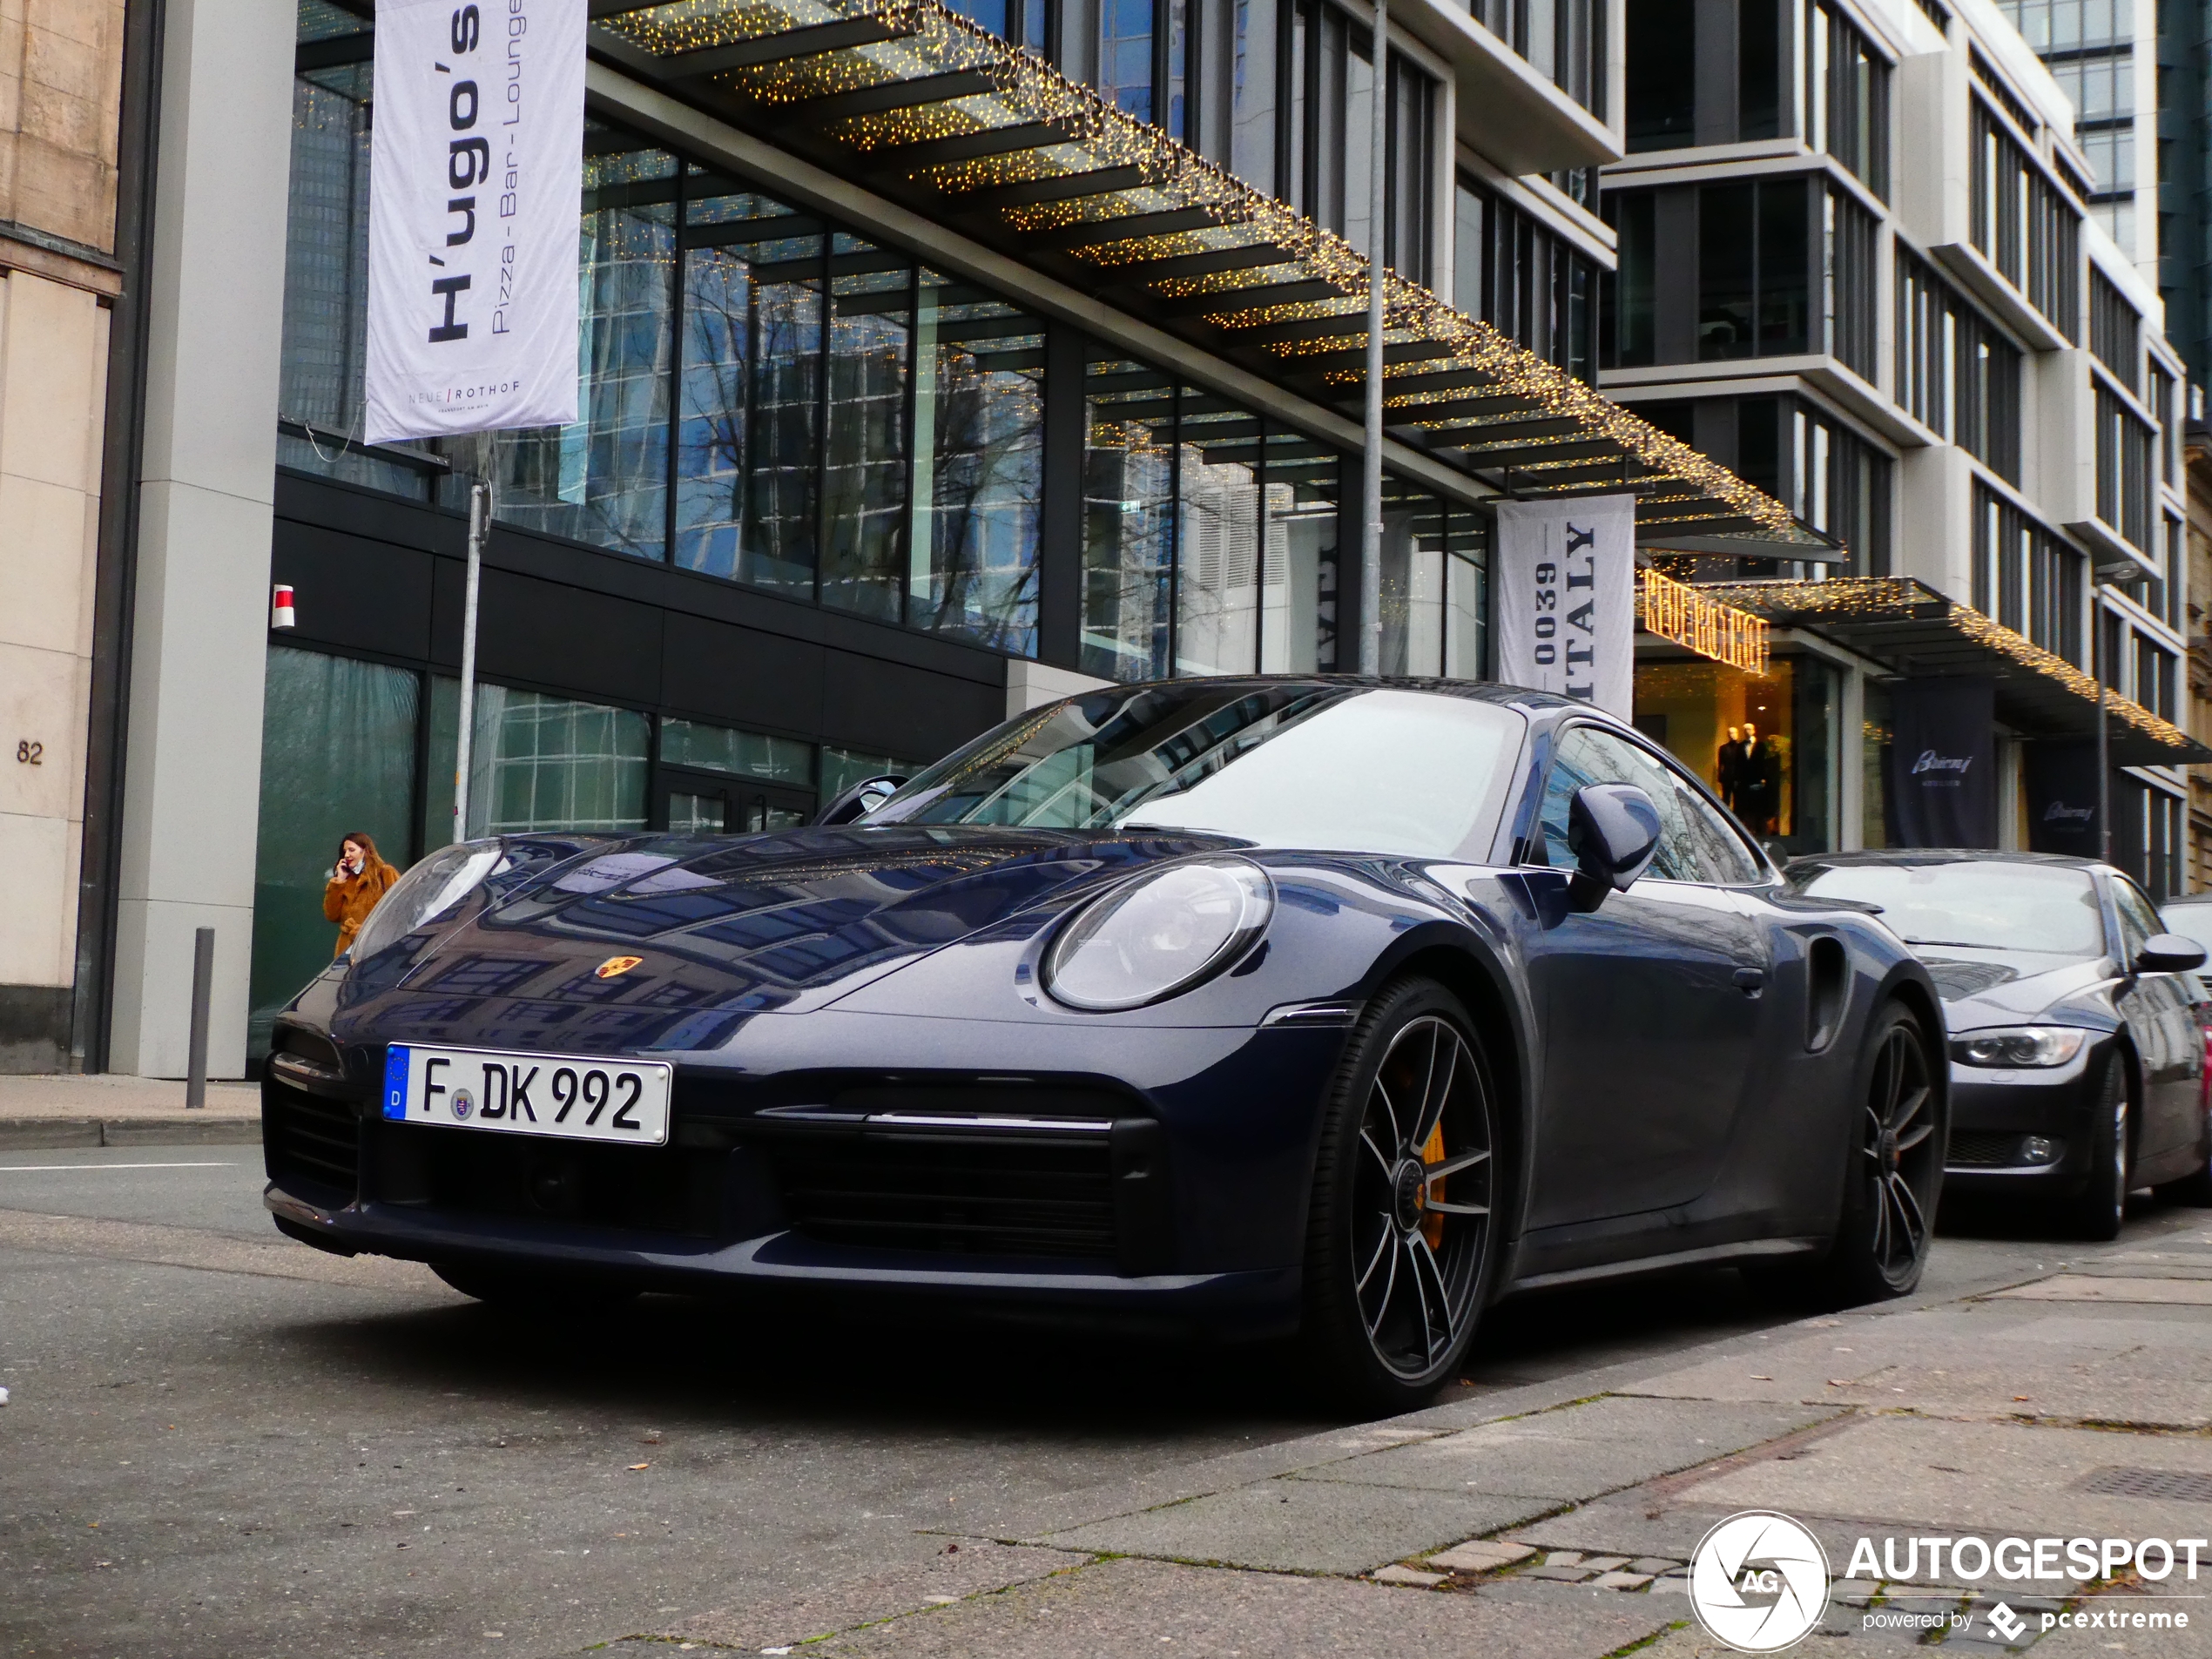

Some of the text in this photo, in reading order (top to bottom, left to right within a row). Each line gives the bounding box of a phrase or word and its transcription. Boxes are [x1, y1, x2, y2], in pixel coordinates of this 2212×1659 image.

[503, 0, 527, 125] Lounge
[428, 3, 489, 343] H'ugo's
[500, 152, 518, 218] Bar
[492, 245, 515, 334] Pizza
[1534, 563, 1556, 664] 0039
[1566, 522, 1594, 702] ITALY
[17, 740, 43, 765] 82
[391, 1090, 401, 1106] D
[424, 1057, 450, 1111] F
[480, 1062, 540, 1122] DK
[551, 1068, 643, 1130] 992
